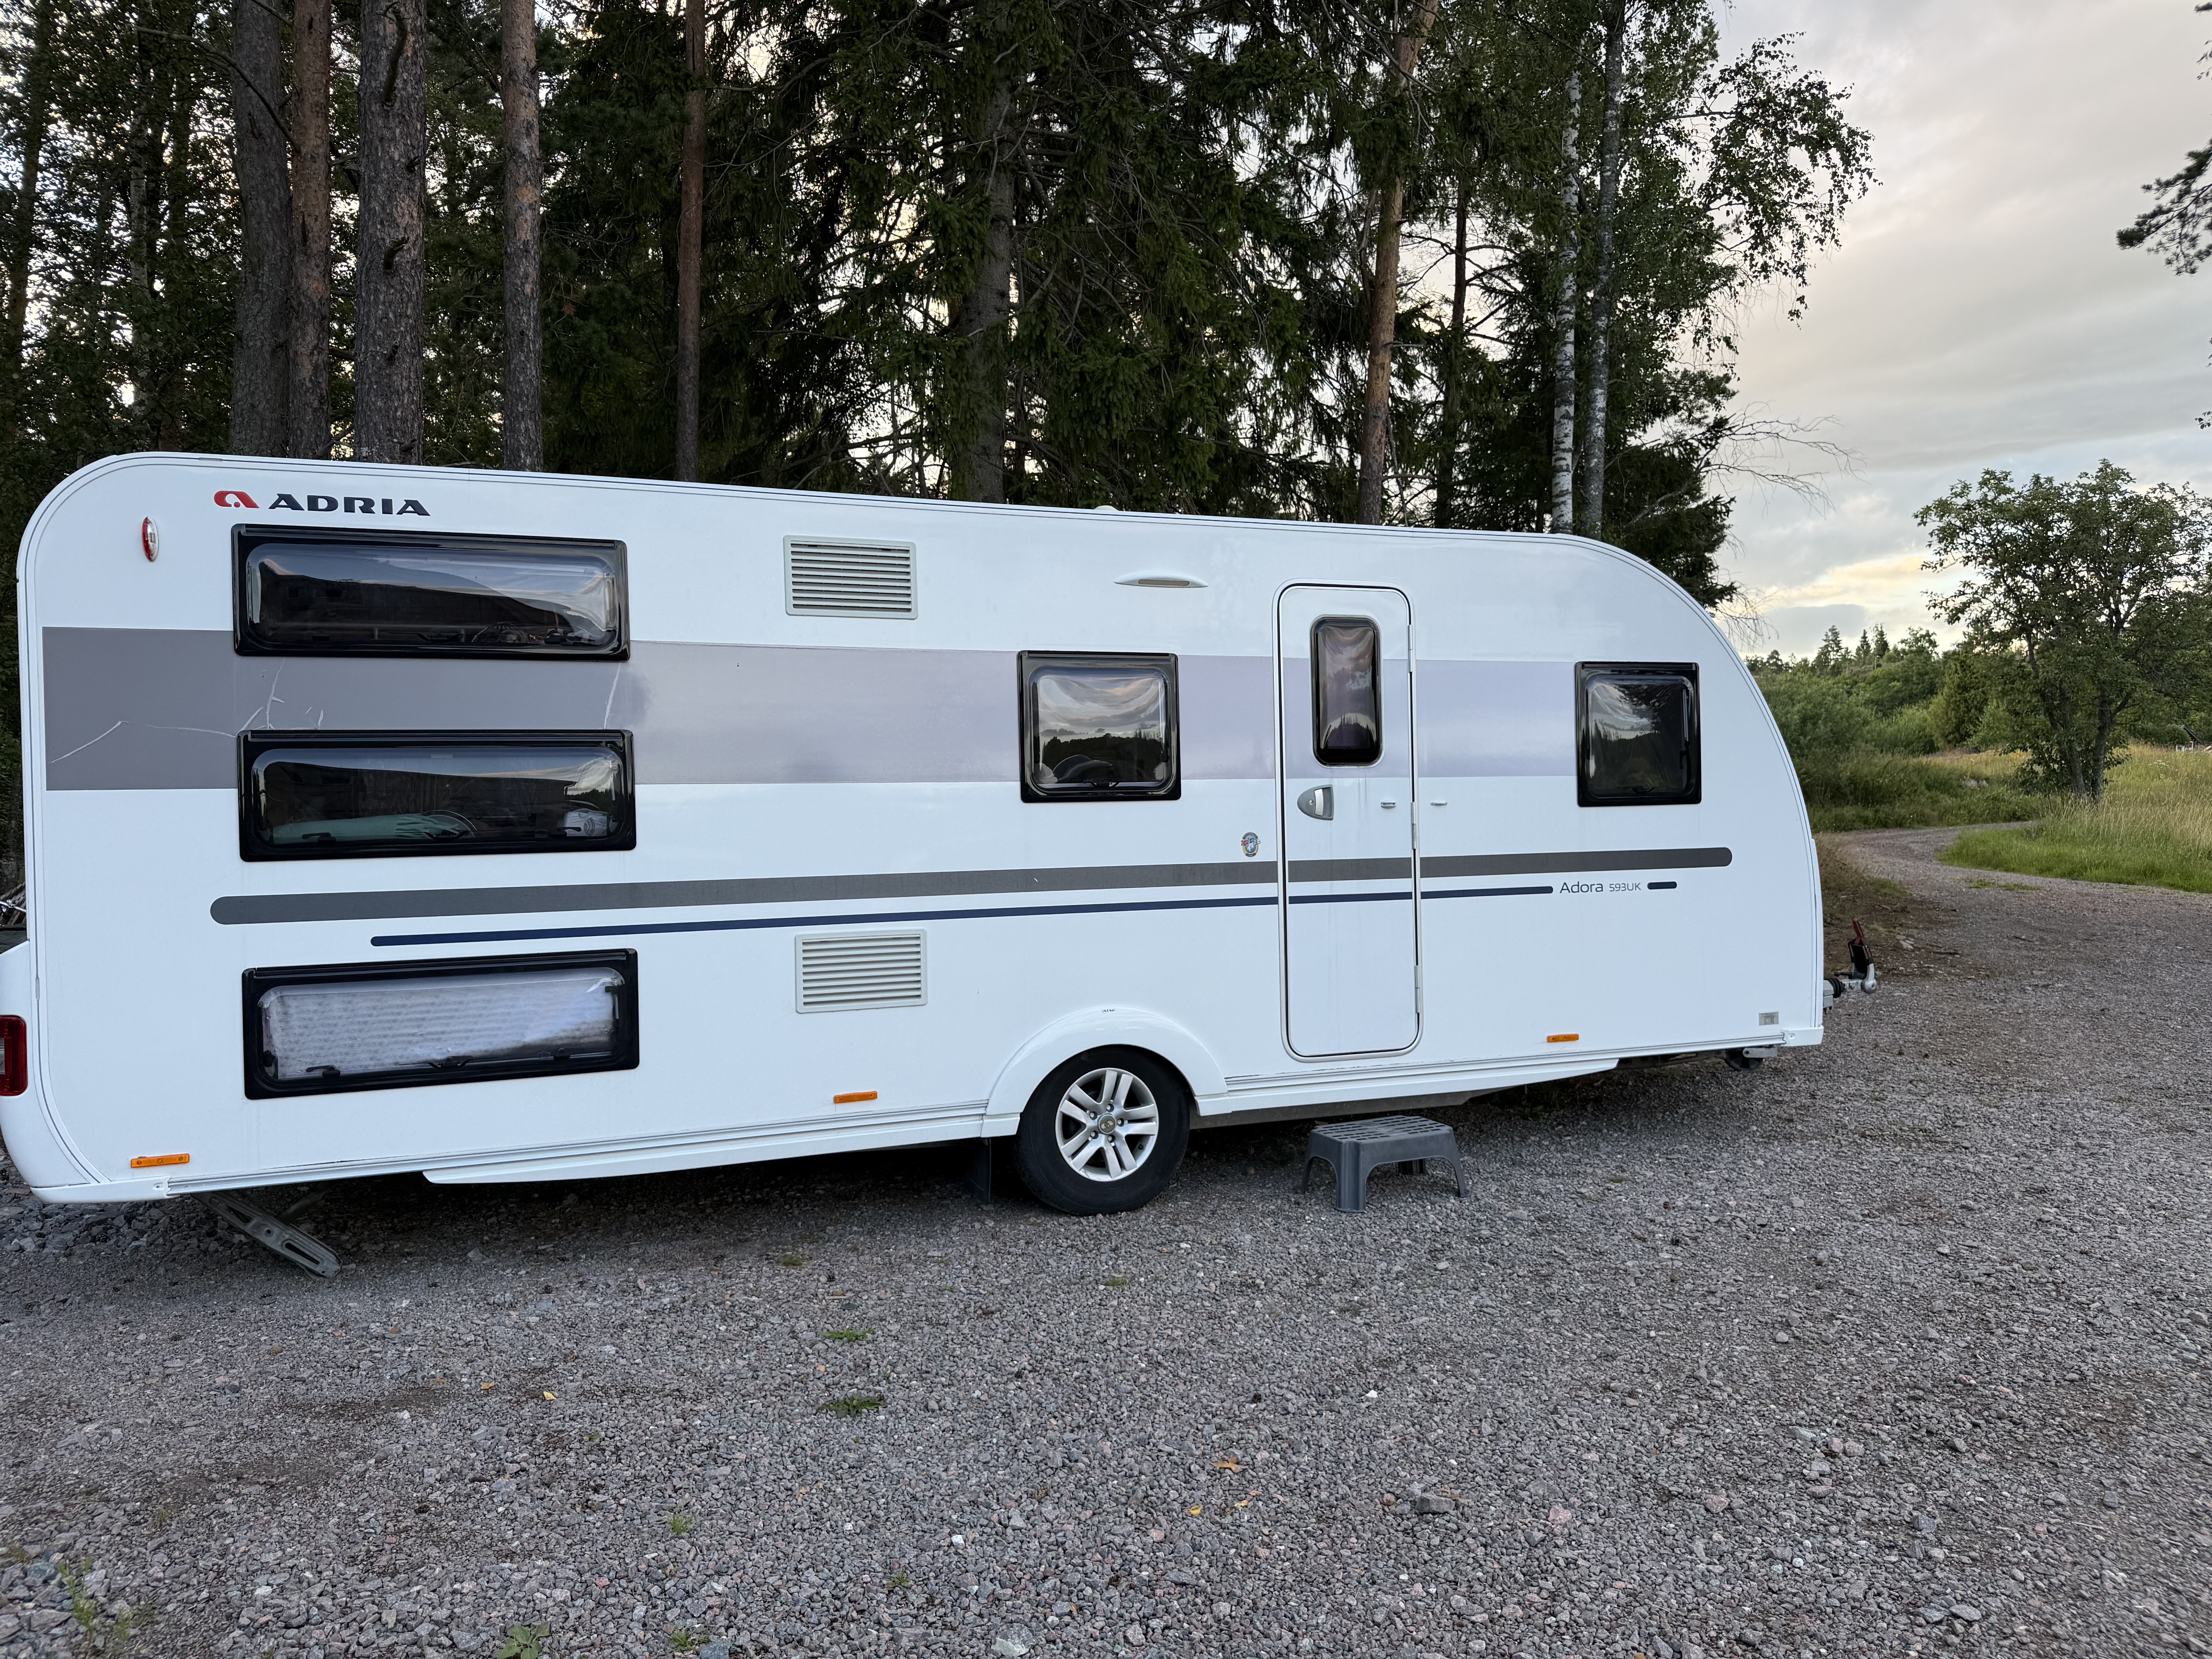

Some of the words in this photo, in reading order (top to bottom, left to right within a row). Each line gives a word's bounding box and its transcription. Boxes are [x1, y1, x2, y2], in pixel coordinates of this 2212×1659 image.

[268, 493, 431, 516] ADRIA
[1559, 881, 1604, 893] Adora
[1609, 883, 1641, 892] 593UK
